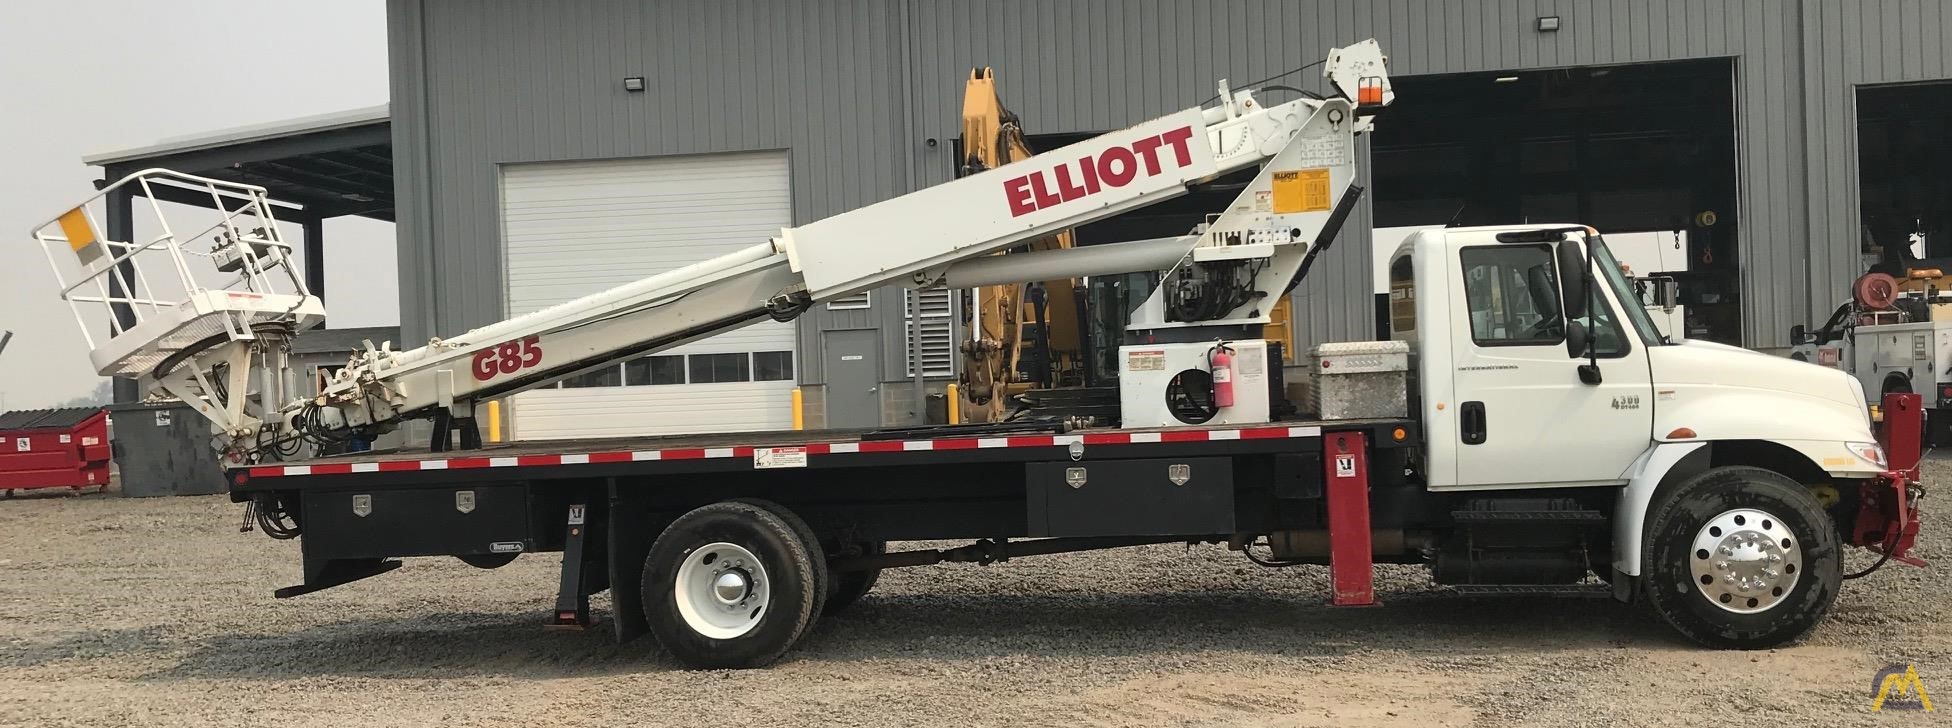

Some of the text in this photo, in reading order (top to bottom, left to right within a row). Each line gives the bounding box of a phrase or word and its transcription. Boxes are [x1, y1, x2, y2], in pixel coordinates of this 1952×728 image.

[1003, 125, 1193, 218] ELLIOTT
[1273, 172, 1298, 180] ELLIOTT
[472, 335, 543, 381] G85
